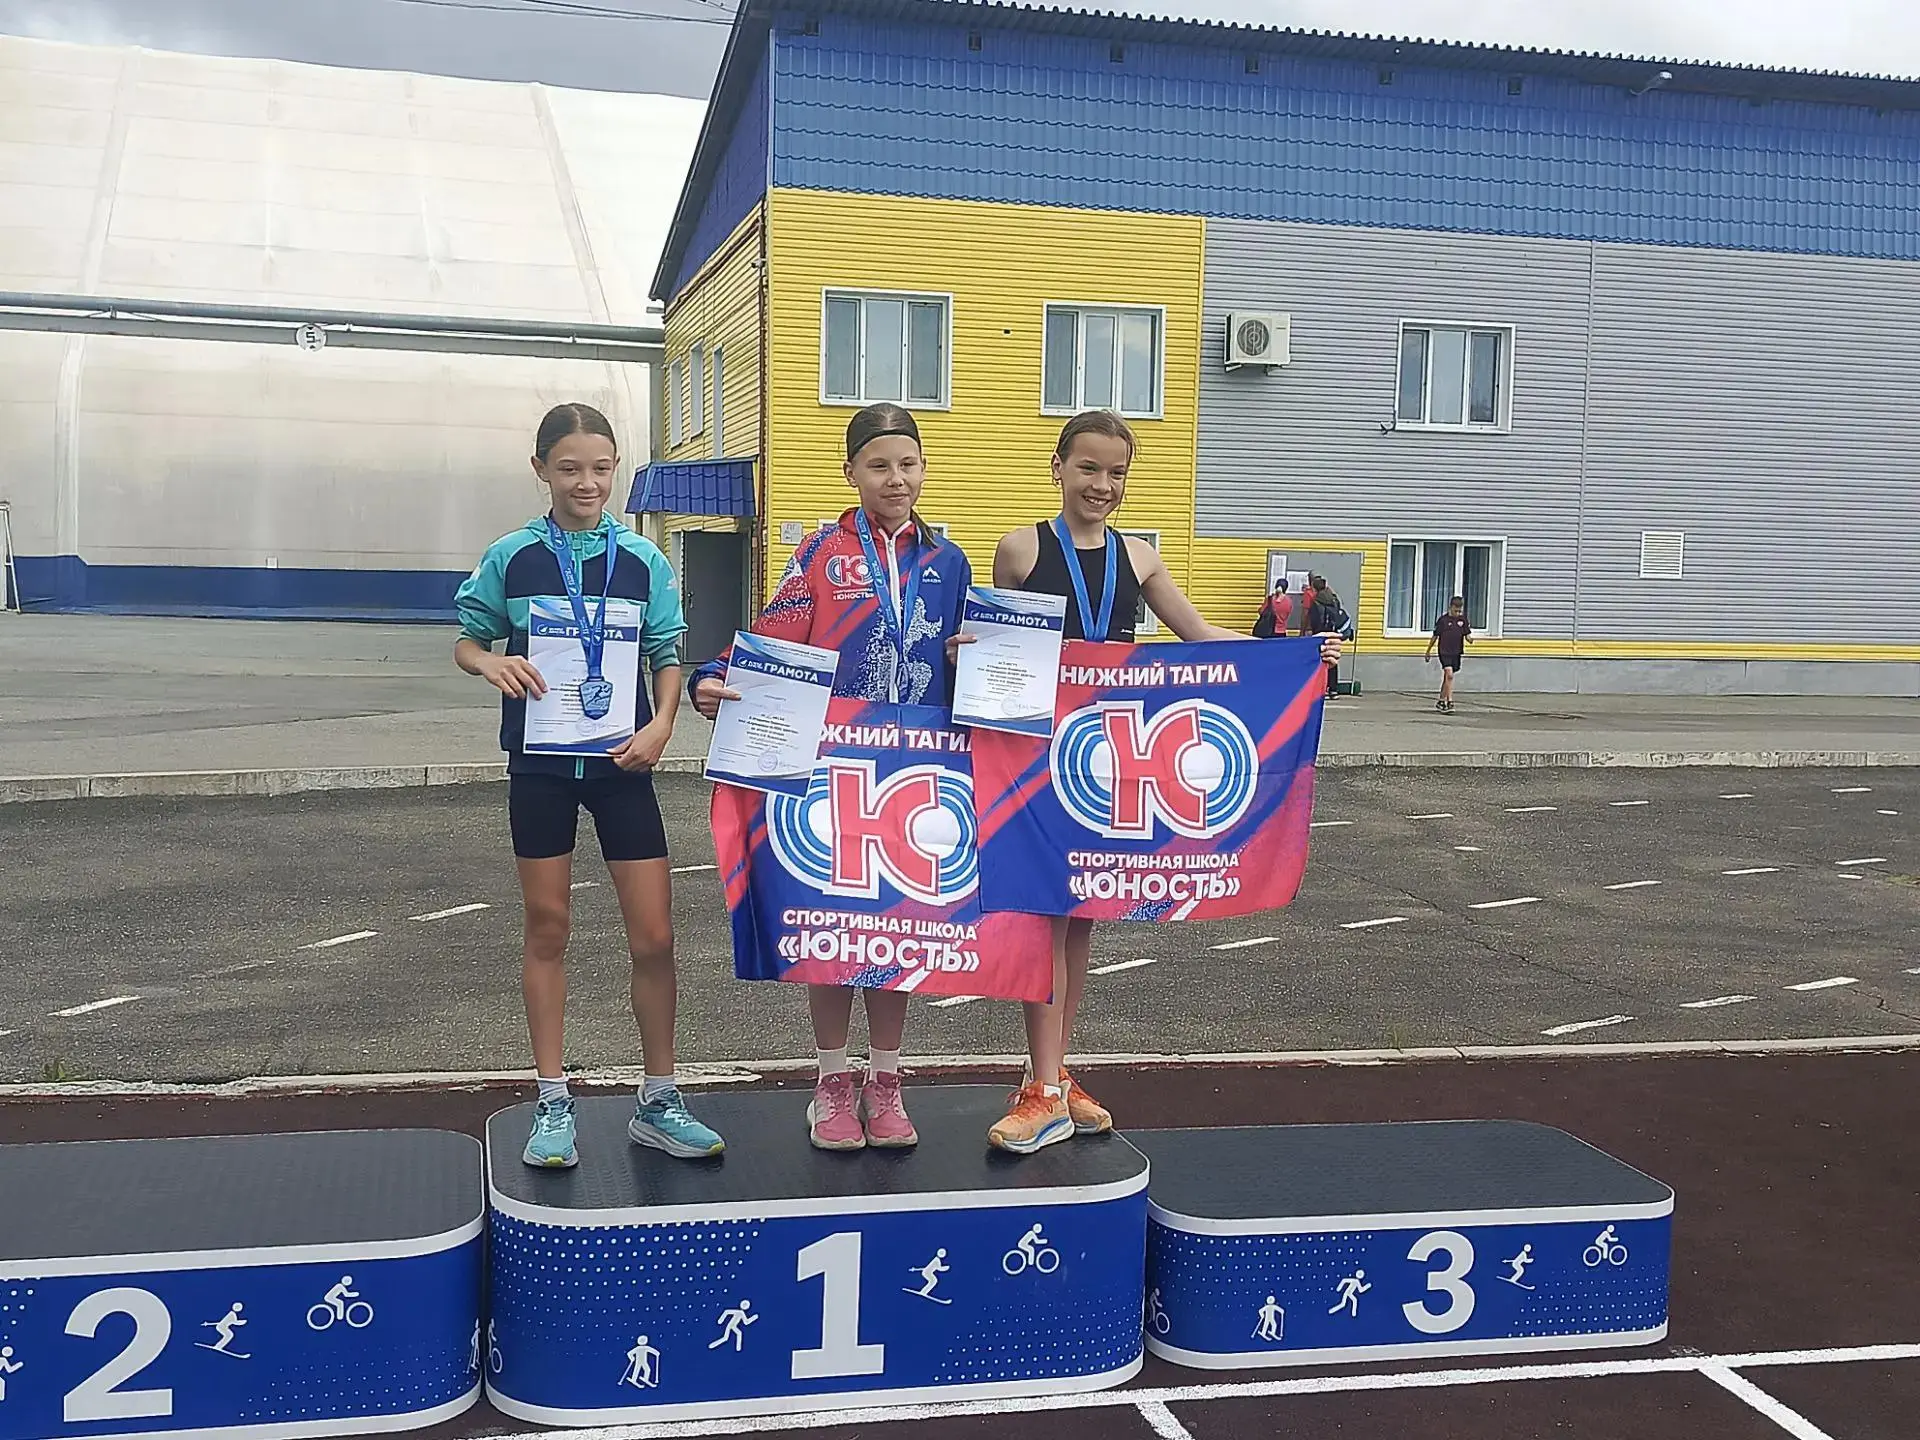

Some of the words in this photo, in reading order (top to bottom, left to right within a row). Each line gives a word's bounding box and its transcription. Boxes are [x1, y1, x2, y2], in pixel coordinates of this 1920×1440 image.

[996, 613, 1048, 628] ГРАМОТА
[764, 662, 818, 682] ГРАМОТА
[1060, 661, 1165, 687] НИЖНИЙ
[1169, 664, 1238, 685] ТАГИЛ
[1068, 852, 1182, 869] СПОРТИВНАЯ
[1186, 853, 1239, 867] ШКОЛА
[1068, 871, 1240, 900] «ЮНОСТЬ»
[783, 909, 912, 934] СПОРТИВНАЯ
[916, 922, 977, 940] ШКОЛА
[777, 928, 980, 972] «ЮНОСТЬ»
[1402, 1230, 1476, 1334] 3
[790, 1231, 885, 1380] 1
[63, 1286, 173, 1423] 2
